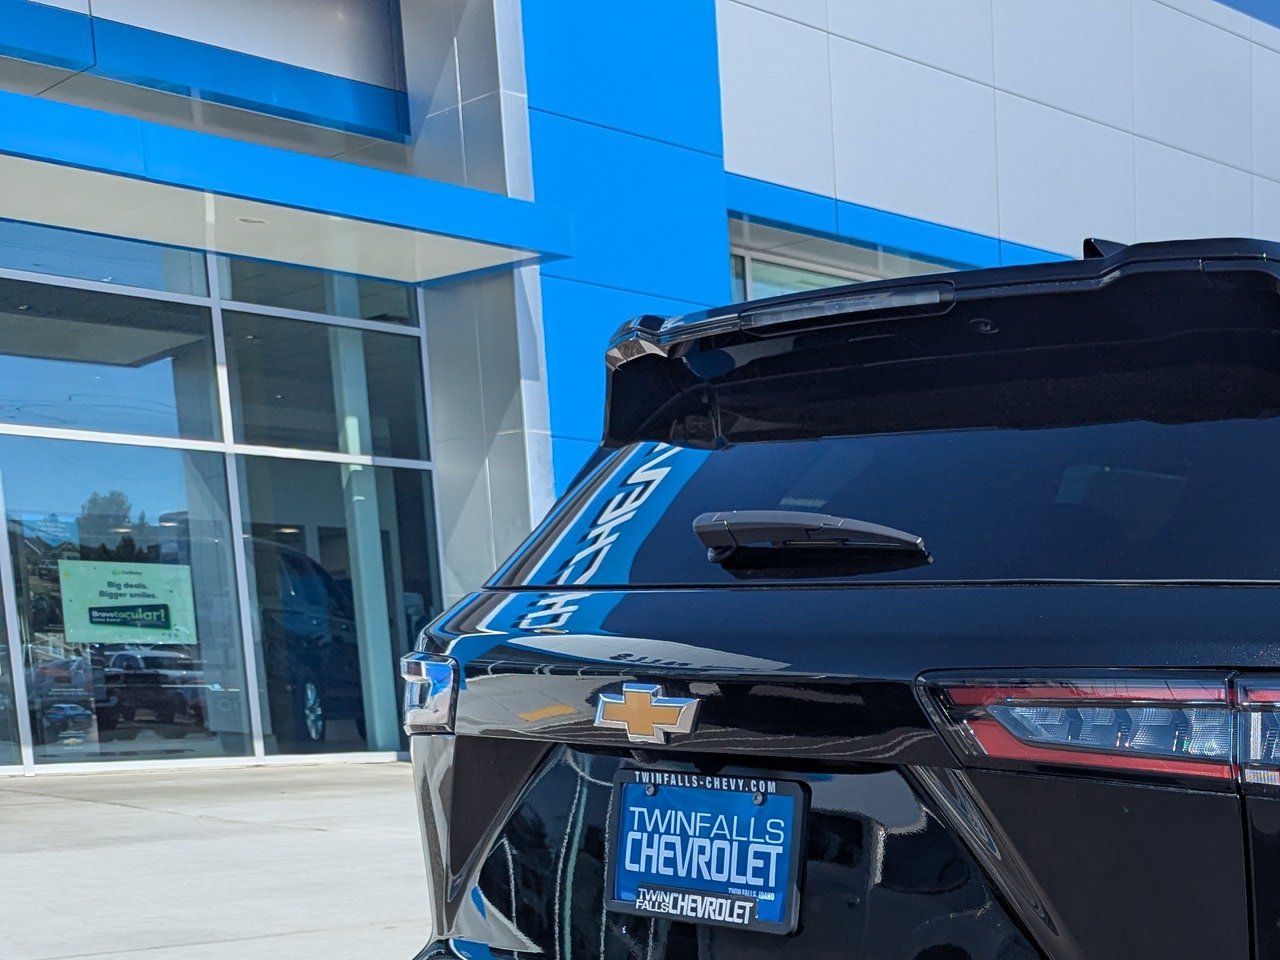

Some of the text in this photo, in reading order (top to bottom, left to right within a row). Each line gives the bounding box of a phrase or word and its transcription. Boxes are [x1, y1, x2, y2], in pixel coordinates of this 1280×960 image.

[99, 591, 128, 600] Bigger
[107, 581, 122, 590] Big
[634, 771, 777, 794] TWINFALLS-CHEVY.COM
[629, 806, 785, 844] TWINFALLS
[625, 831, 783, 888] CHEVROLET
[638, 888, 670, 903] TWIN
[635, 892, 754, 925] FALLS CHEVROLET
